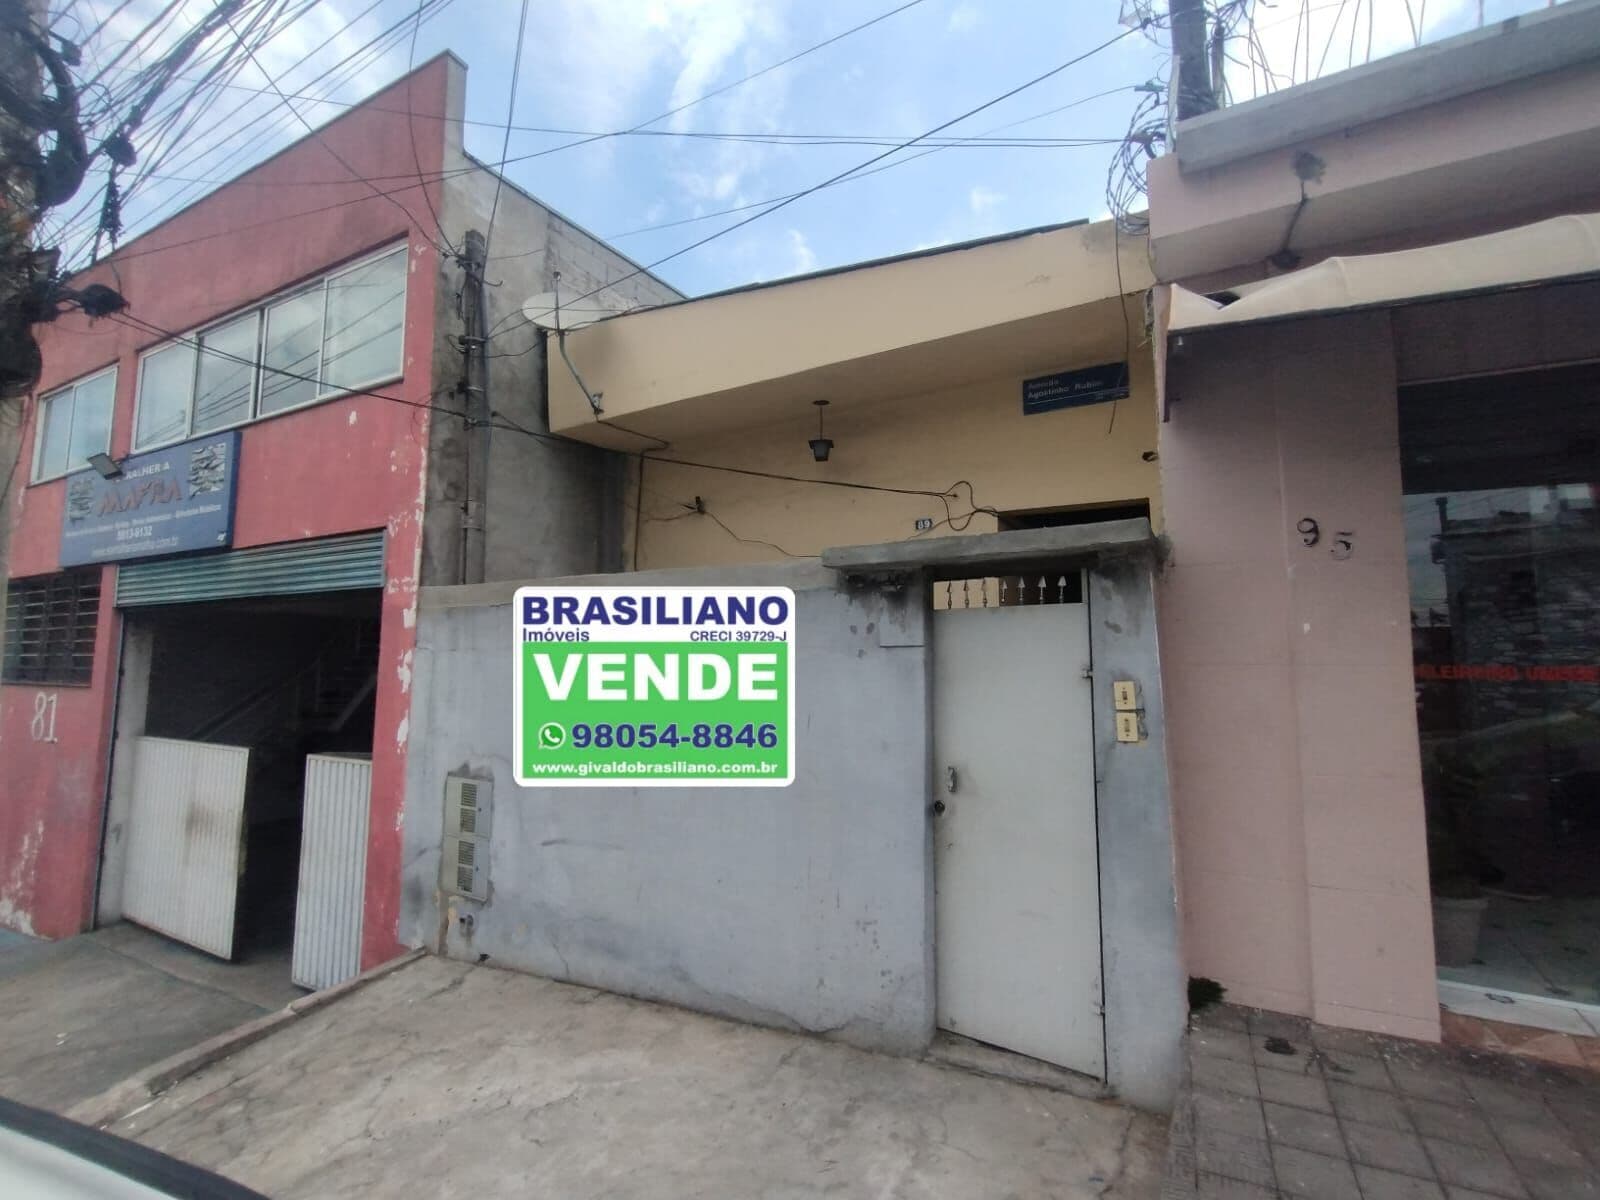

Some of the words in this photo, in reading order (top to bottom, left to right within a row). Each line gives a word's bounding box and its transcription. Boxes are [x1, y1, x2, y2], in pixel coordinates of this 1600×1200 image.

[1028, 385, 1070, 399] Agostinho
[98, 478, 183, 517] MAFRA
[1296, 517, 1353, 560] 95
[31, 691, 58, 742] 81
